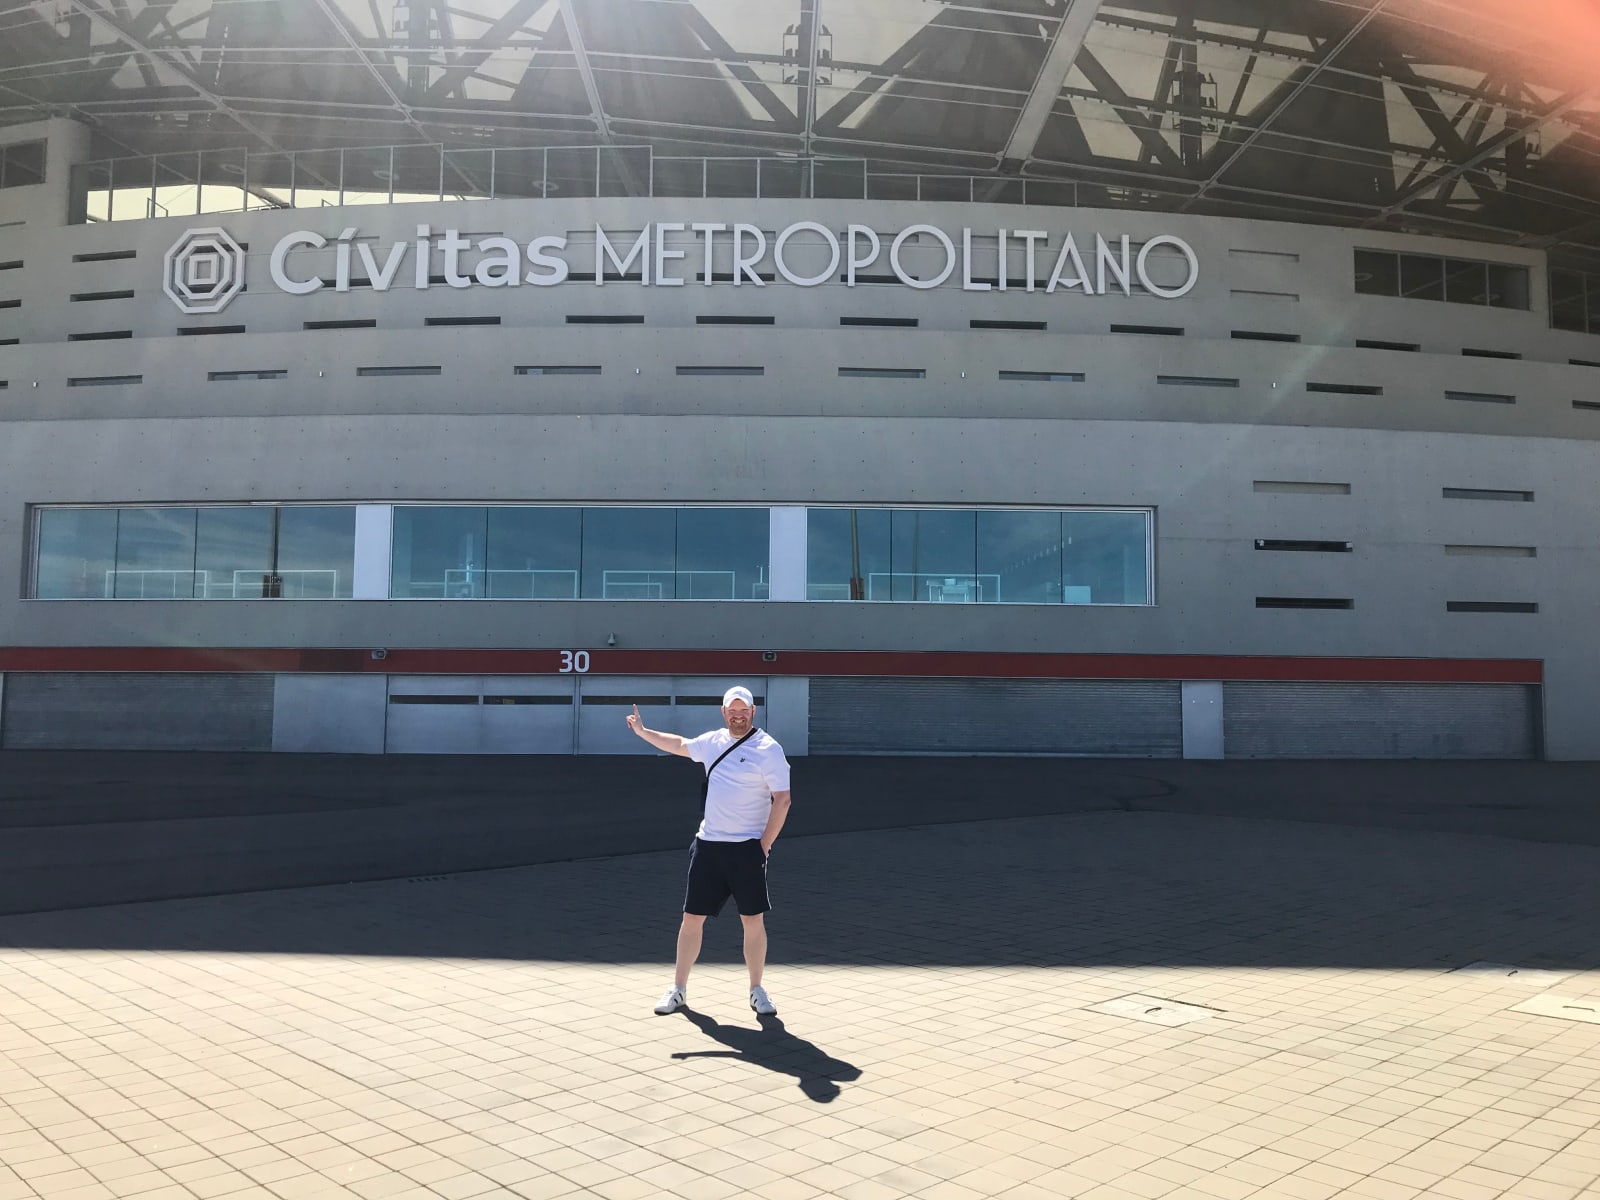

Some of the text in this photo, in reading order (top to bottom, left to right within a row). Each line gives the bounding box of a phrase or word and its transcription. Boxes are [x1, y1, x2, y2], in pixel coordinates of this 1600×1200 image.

[269, 221, 1200, 299] Cívitas METROPOLITANO
[559, 650, 590, 673] 30
